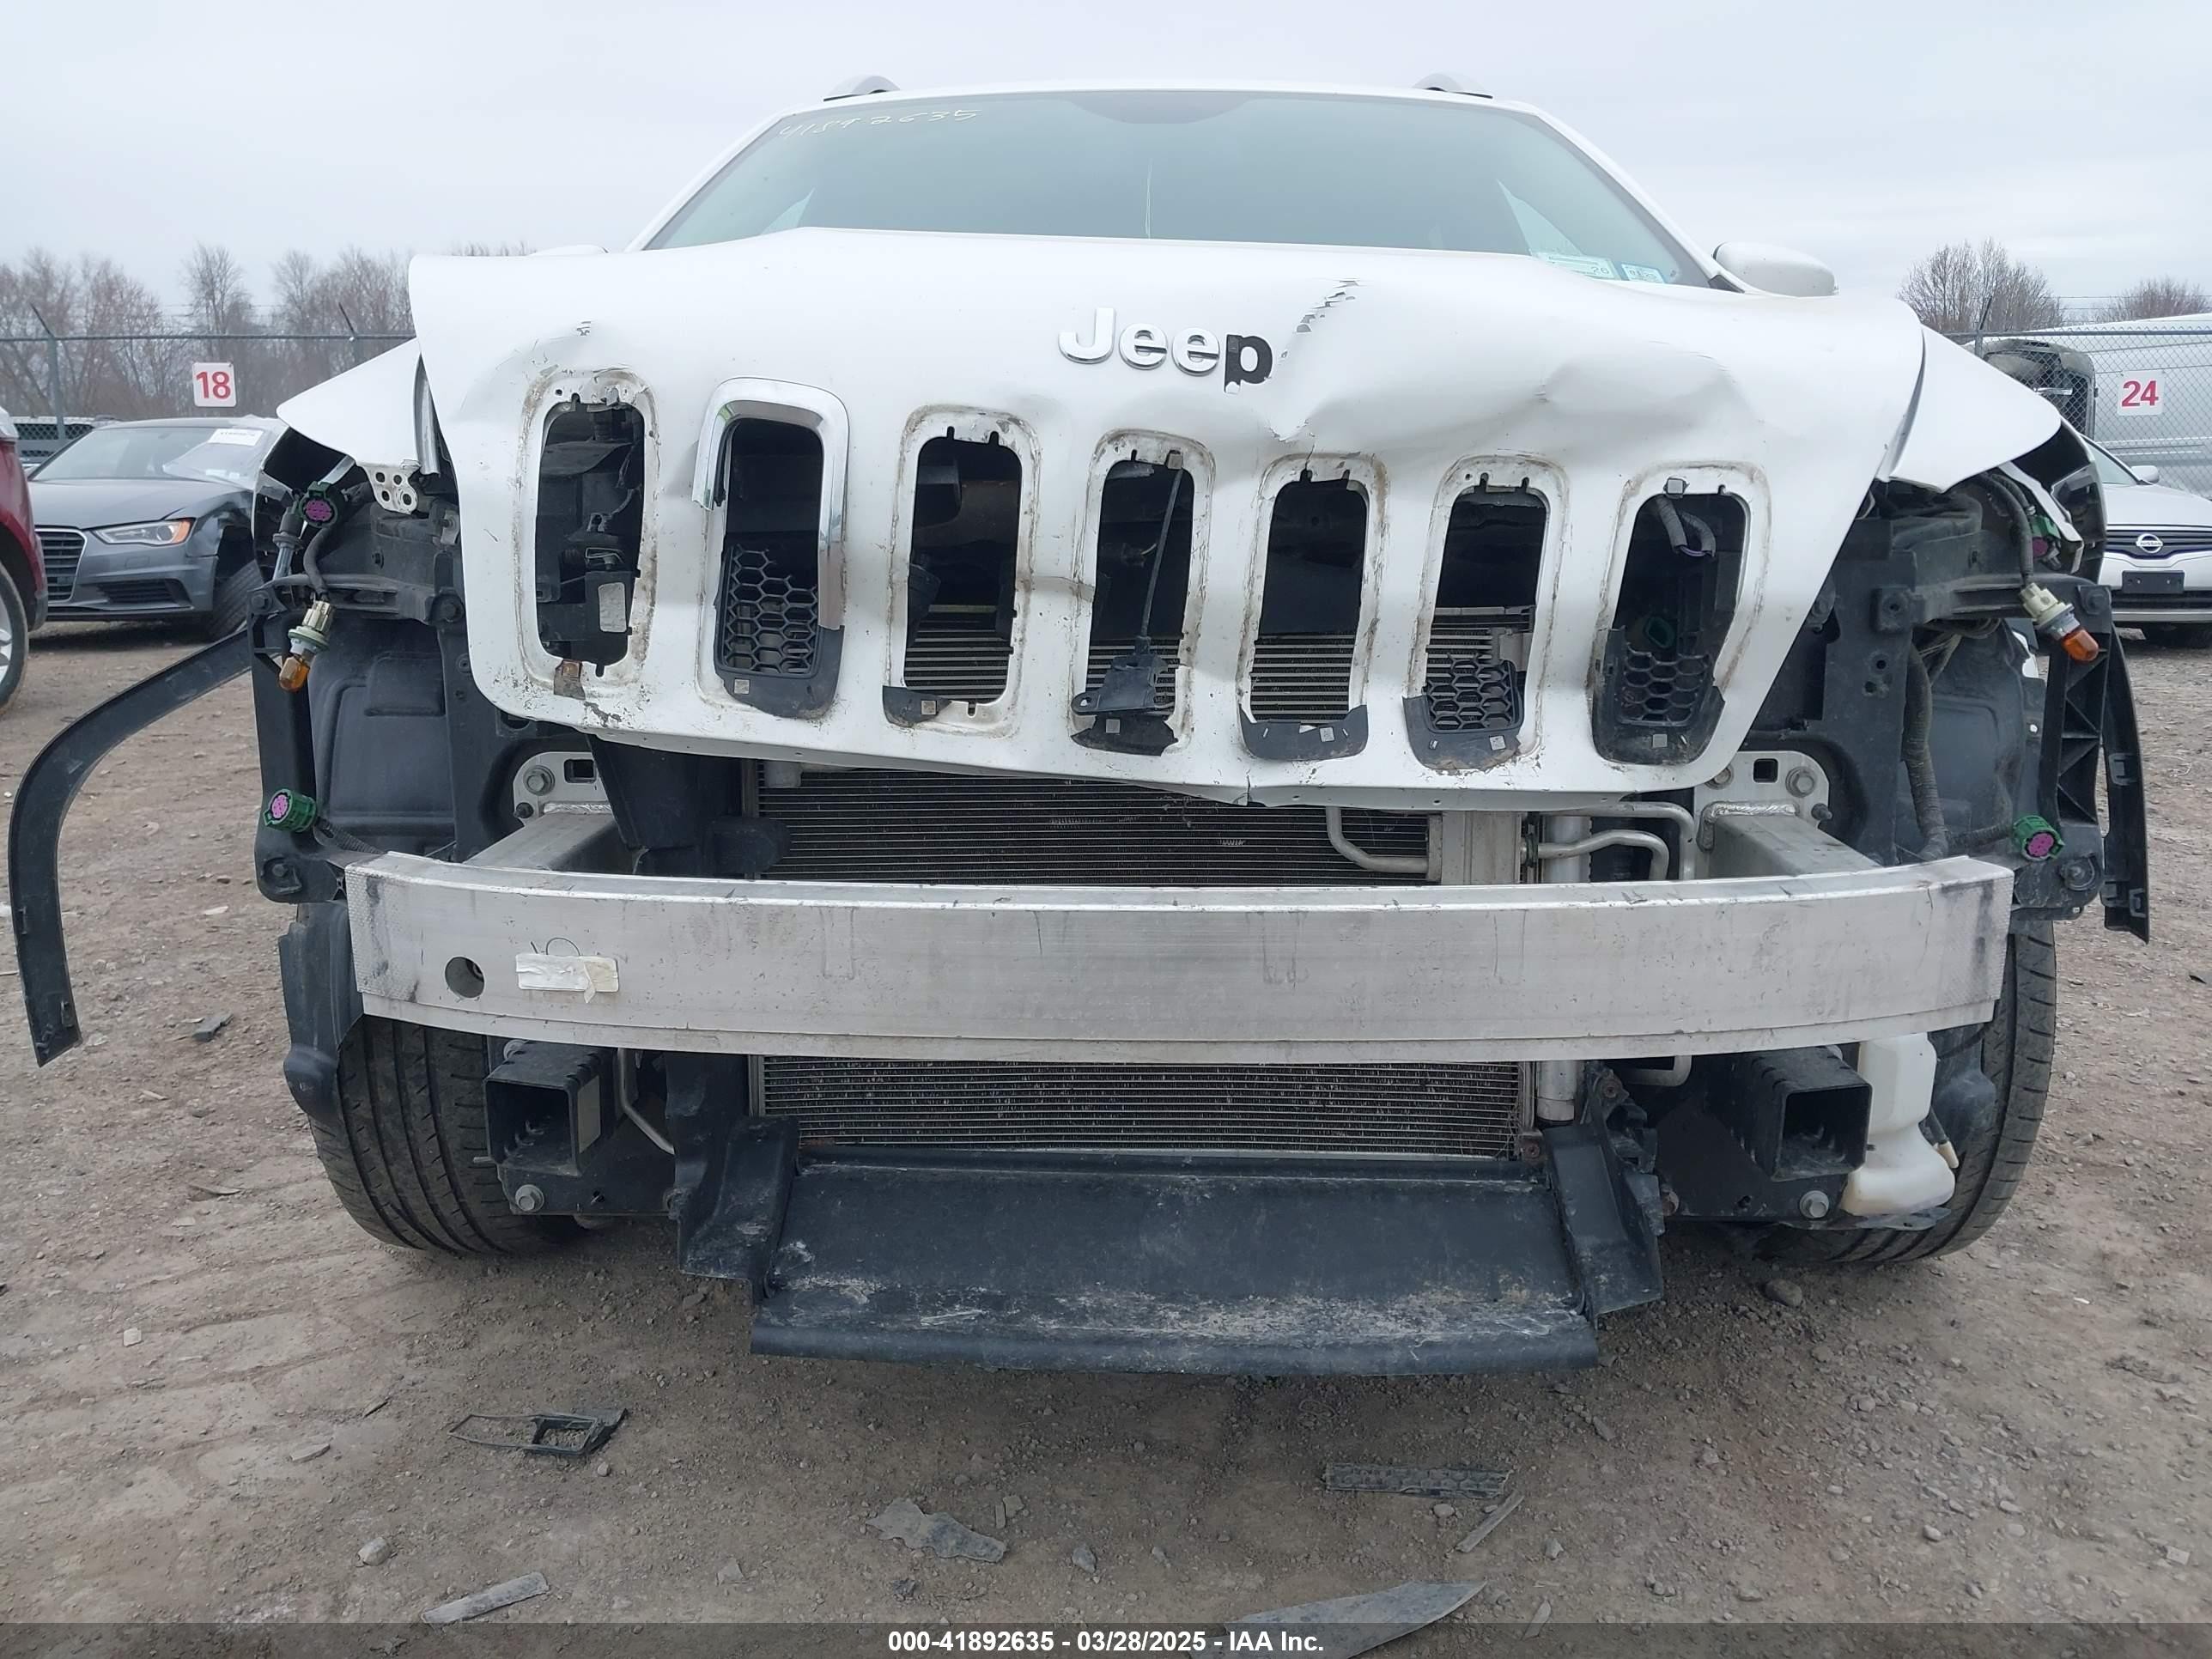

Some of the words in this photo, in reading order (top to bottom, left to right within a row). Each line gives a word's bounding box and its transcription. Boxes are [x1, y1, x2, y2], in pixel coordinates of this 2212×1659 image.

[1058, 307, 1273, 393] Jeep
[196, 371, 231, 399] 18
[2121, 380, 2159, 407] 24
